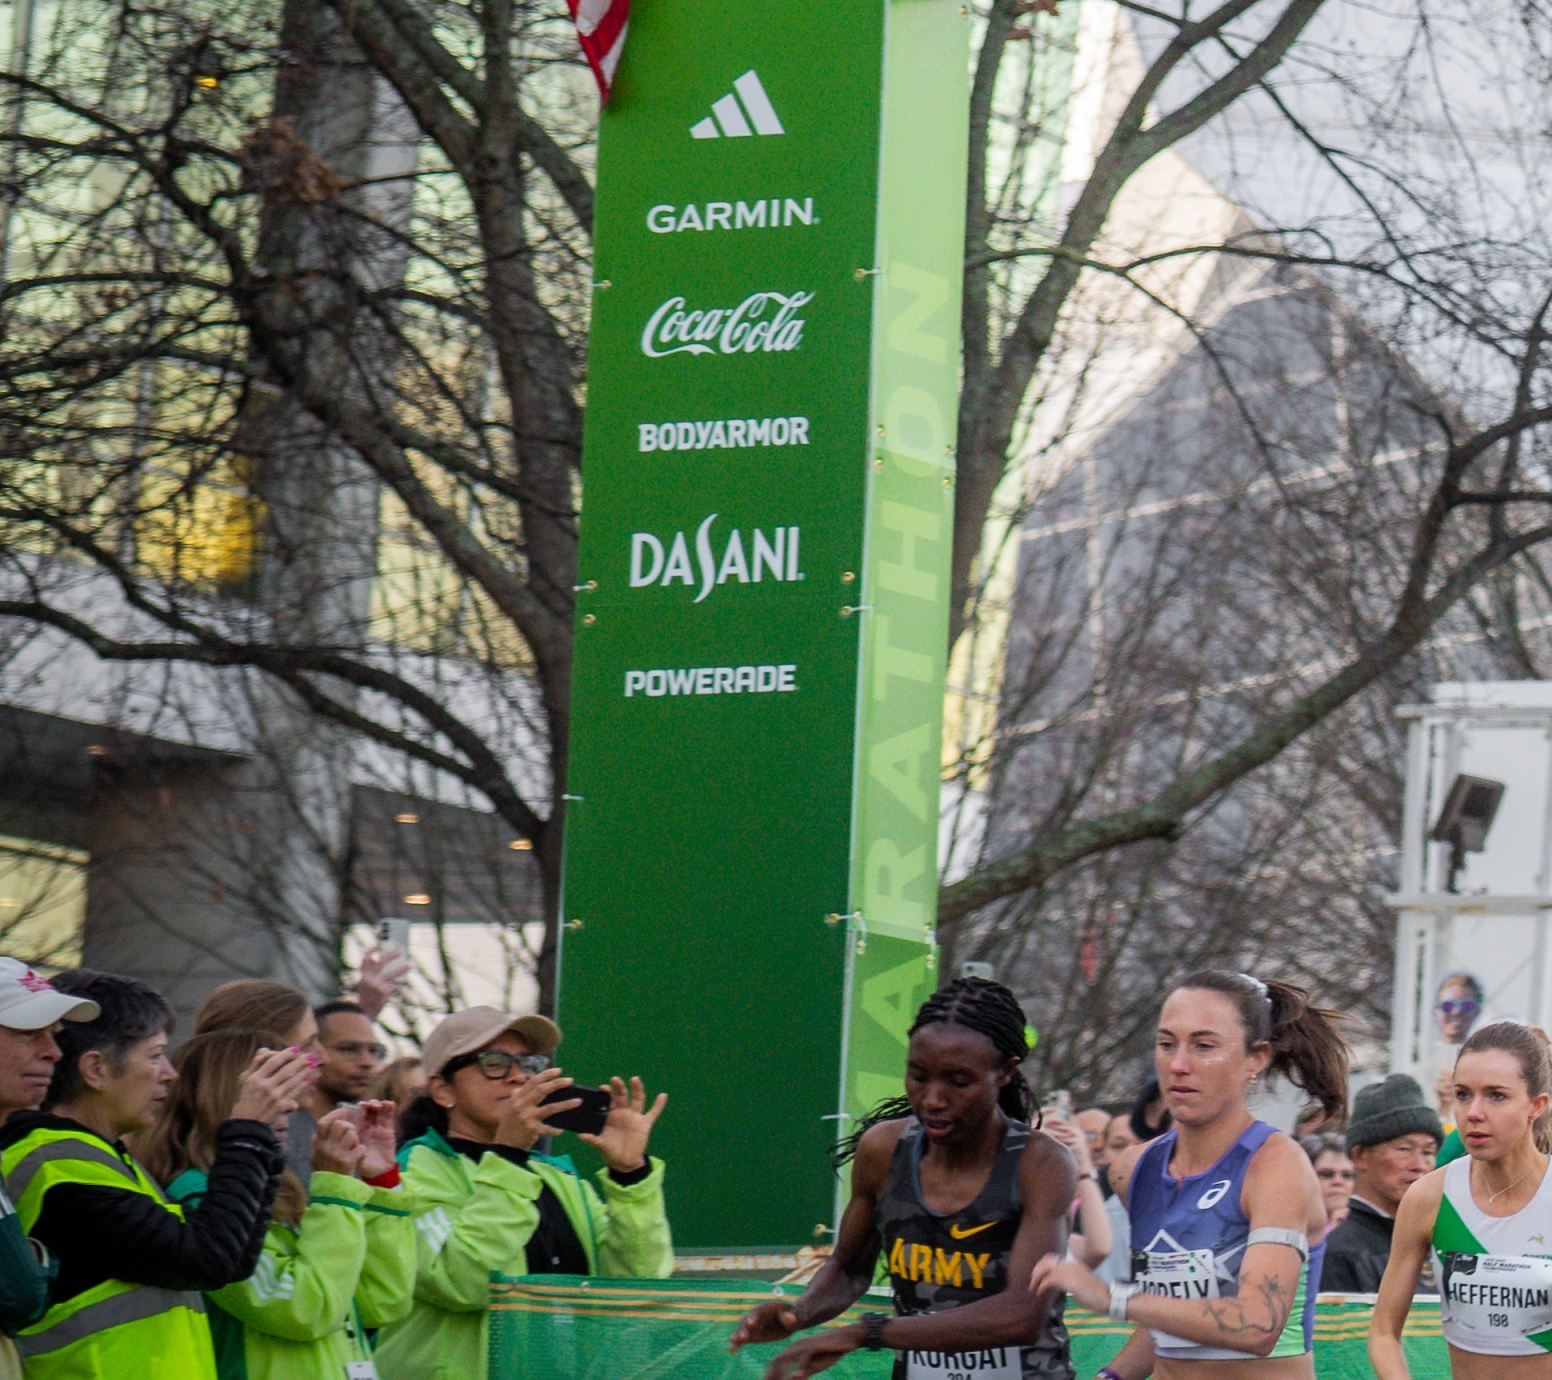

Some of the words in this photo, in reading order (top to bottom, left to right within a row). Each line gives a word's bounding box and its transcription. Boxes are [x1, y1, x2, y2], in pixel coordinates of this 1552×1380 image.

[647, 198, 819, 233] GARMIN
[642, 292, 814, 357] Coca-Cola
[639, 417, 810, 452] BODYARMOR
[630, 515, 804, 603] DASANI
[625, 665, 799, 697] POWERADE
[890, 1238, 991, 1289] ARMY
[1448, 1282, 1549, 1309] HEFFERNAN
[1488, 1313, 1509, 1327] 198
